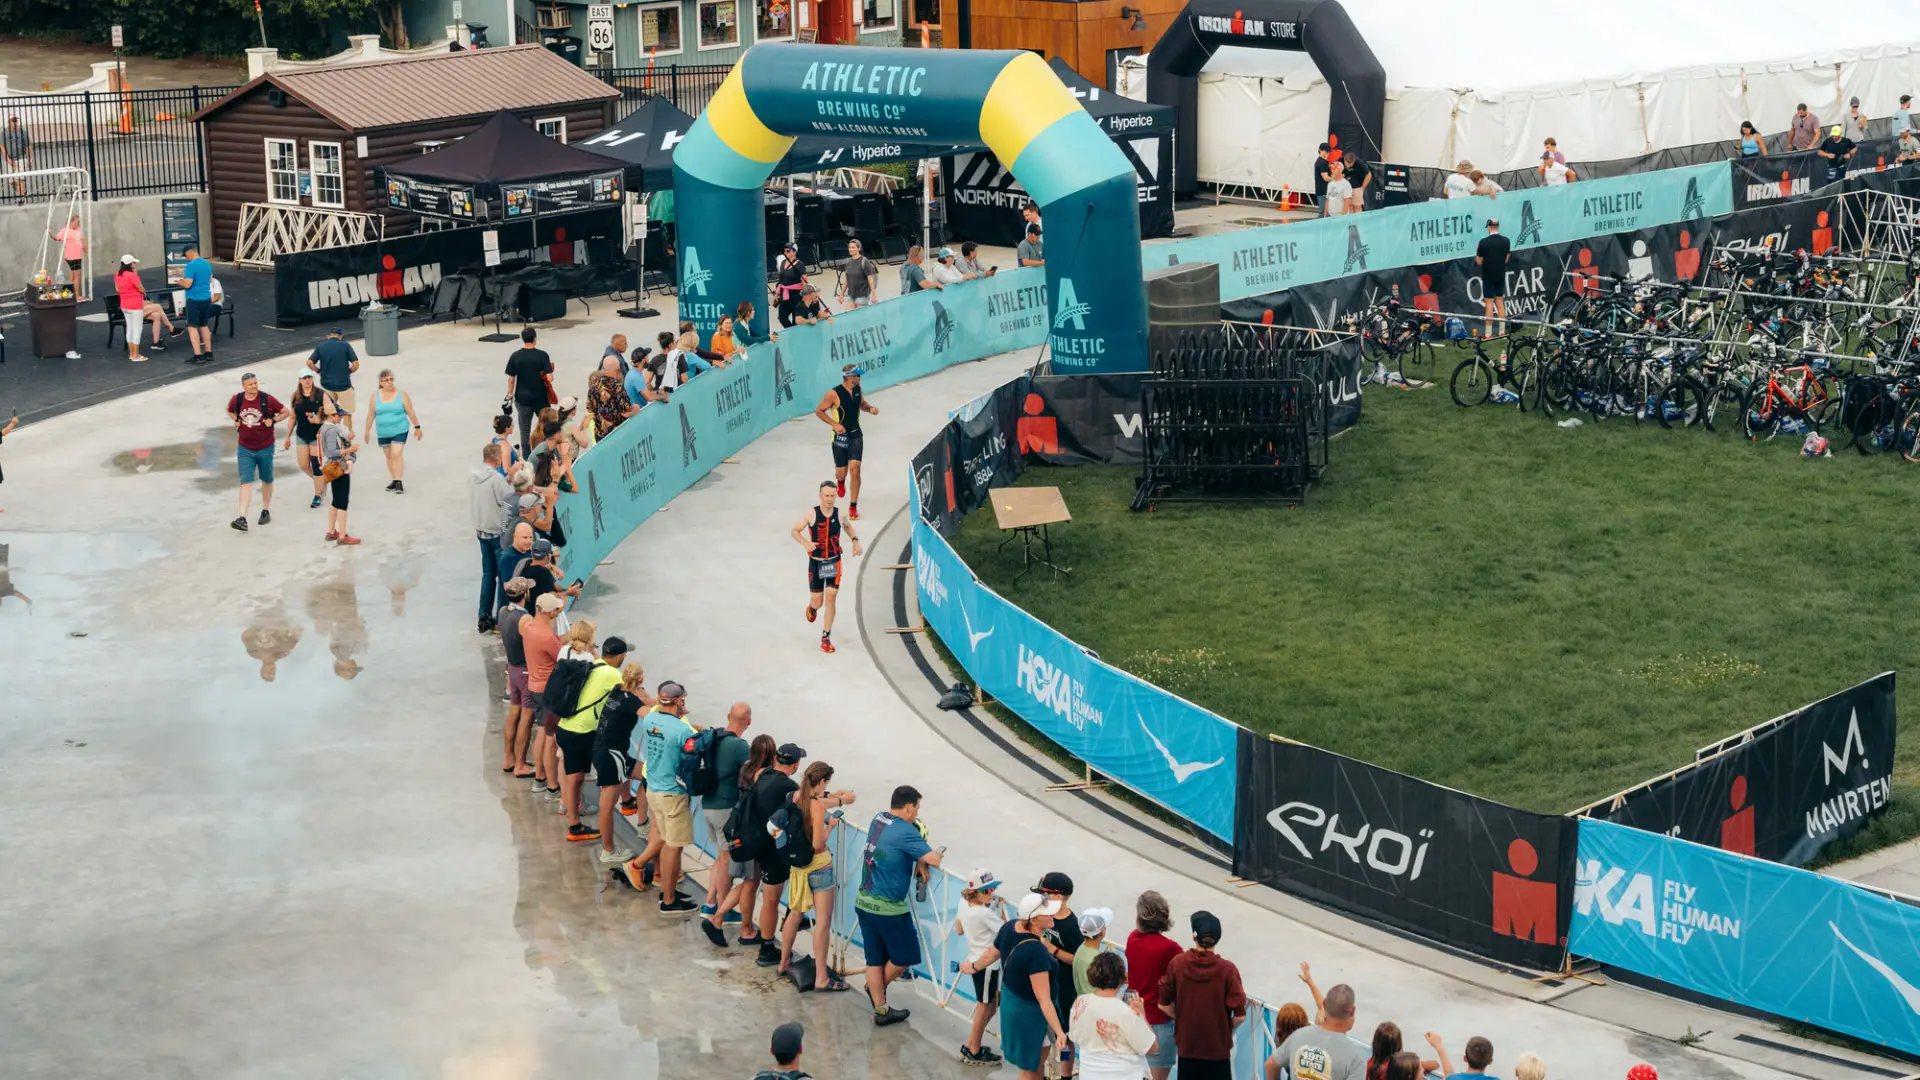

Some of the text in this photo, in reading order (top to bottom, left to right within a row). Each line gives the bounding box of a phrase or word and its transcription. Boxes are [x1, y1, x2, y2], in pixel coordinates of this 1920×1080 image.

[592, 7, 609, 17] EAST
[1199, 10, 1297, 38] IRONMAN STORE
[594, 28, 610, 44] 86
[801, 61, 926, 97] ATHLETIC
[817, 100, 880, 119] BREWING
[812, 121, 928, 137] NON-ALCOHOLIC BREWS
[1110, 114, 1153, 131] Hyperice
[852, 143, 902, 161] Hyperice
[1747, 170, 1812, 202] IRONMAN
[954, 188, 1033, 211] NORMATE
[1583, 191, 1643, 218] ATHLETIC
[1410, 214, 1473, 242] ATHLETIC
[1594, 218, 1625, 232] BREWING
[1233, 241, 1299, 272] ATHLETIC
[1420, 244, 1454, 257] BREWING
[308, 254, 442, 310] IRONMAN
[1245, 271, 1280, 287] BREWING
[1467, 266, 1547, 308] QTAR
[679, 303, 725, 319] THLETIC
[988, 284, 1047, 318] ATHLETIC
[1492, 294, 1548, 317] ARWAYS
[1000, 318, 1030, 334] BREWING
[830, 323, 891, 362] ATHLETIC
[1054, 354, 1083, 367] BREWING
[716, 373, 753, 417] ATHLETIC
[621, 433, 656, 484] ATHLETIC
[974, 466, 994, 487] 1884
[1017, 643, 1073, 724] HOKA
[1073, 678, 1084, 699] FLY
[1073, 695, 1103, 727] HUMAN
[1073, 711, 1085, 732] FLY
[1806, 774, 1892, 839] MAURTEN
[1664, 879, 1697, 905] FLY
[1661, 919, 1694, 946] FLY
[1663, 903, 1741, 939] HUMAN
[1300, 1058, 1323, 1071] STATE
